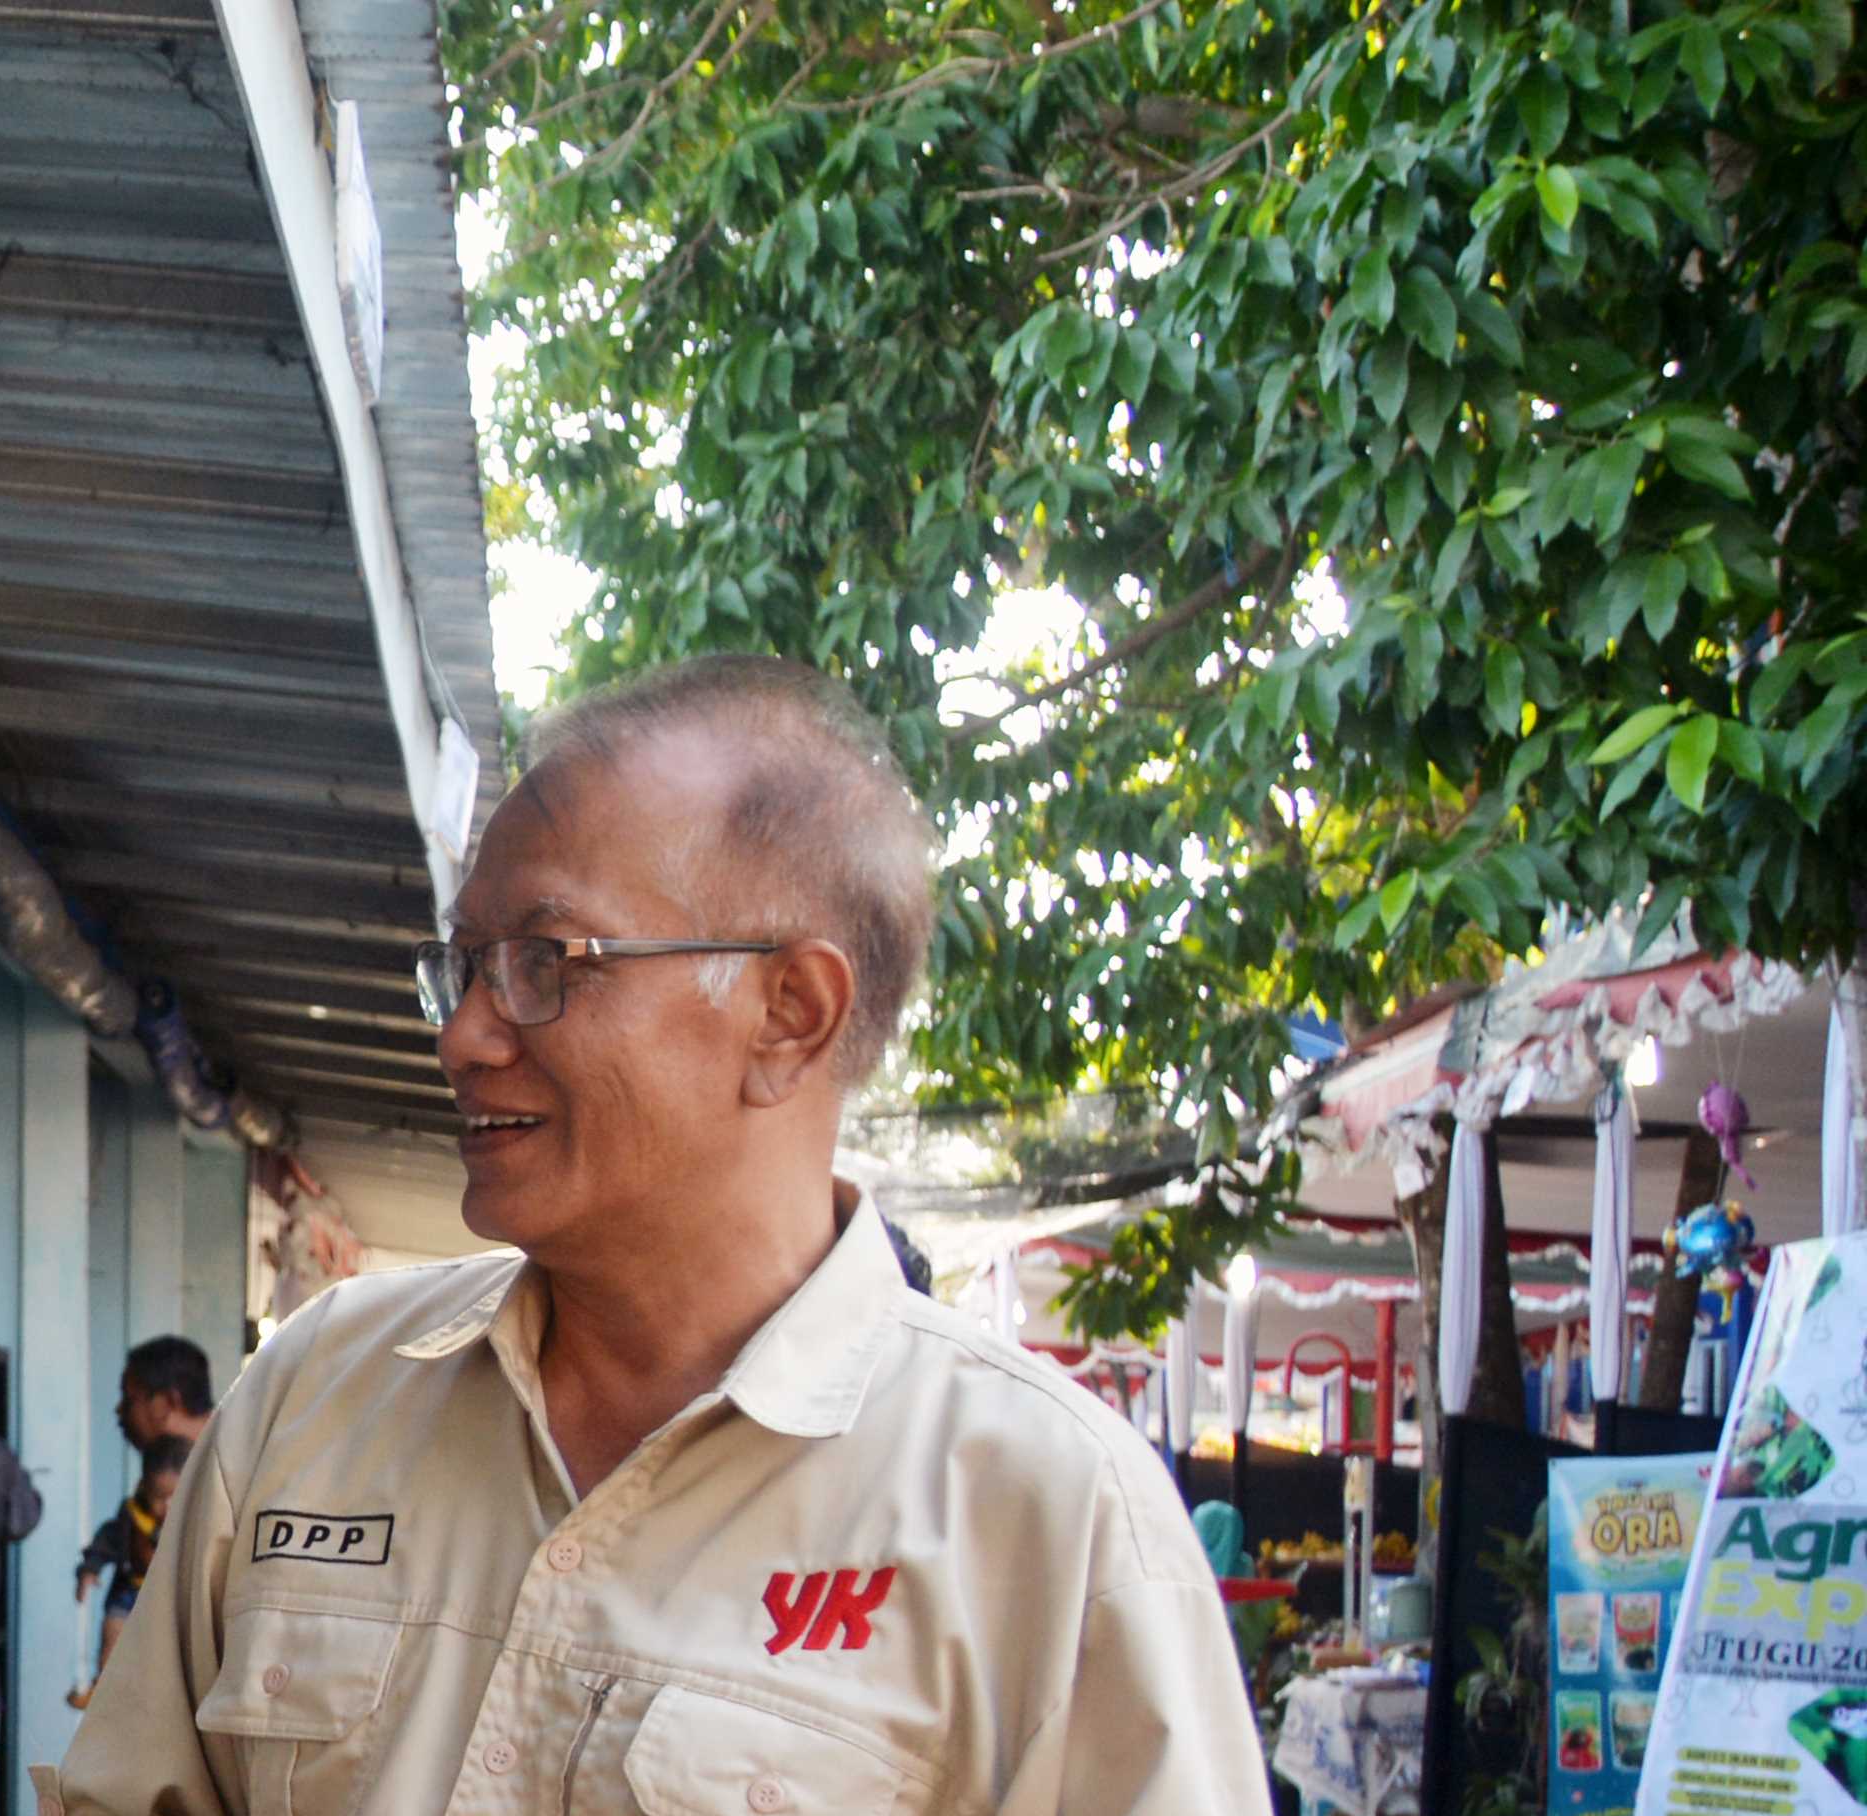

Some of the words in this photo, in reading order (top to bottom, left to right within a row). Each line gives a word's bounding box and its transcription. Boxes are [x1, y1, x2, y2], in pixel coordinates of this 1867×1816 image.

[270, 1521, 364, 1553] DPP
[1591, 1508, 1682, 1555] ORA
[1711, 1505, 1867, 1582] Agr
[762, 1567, 898, 1656] YK
